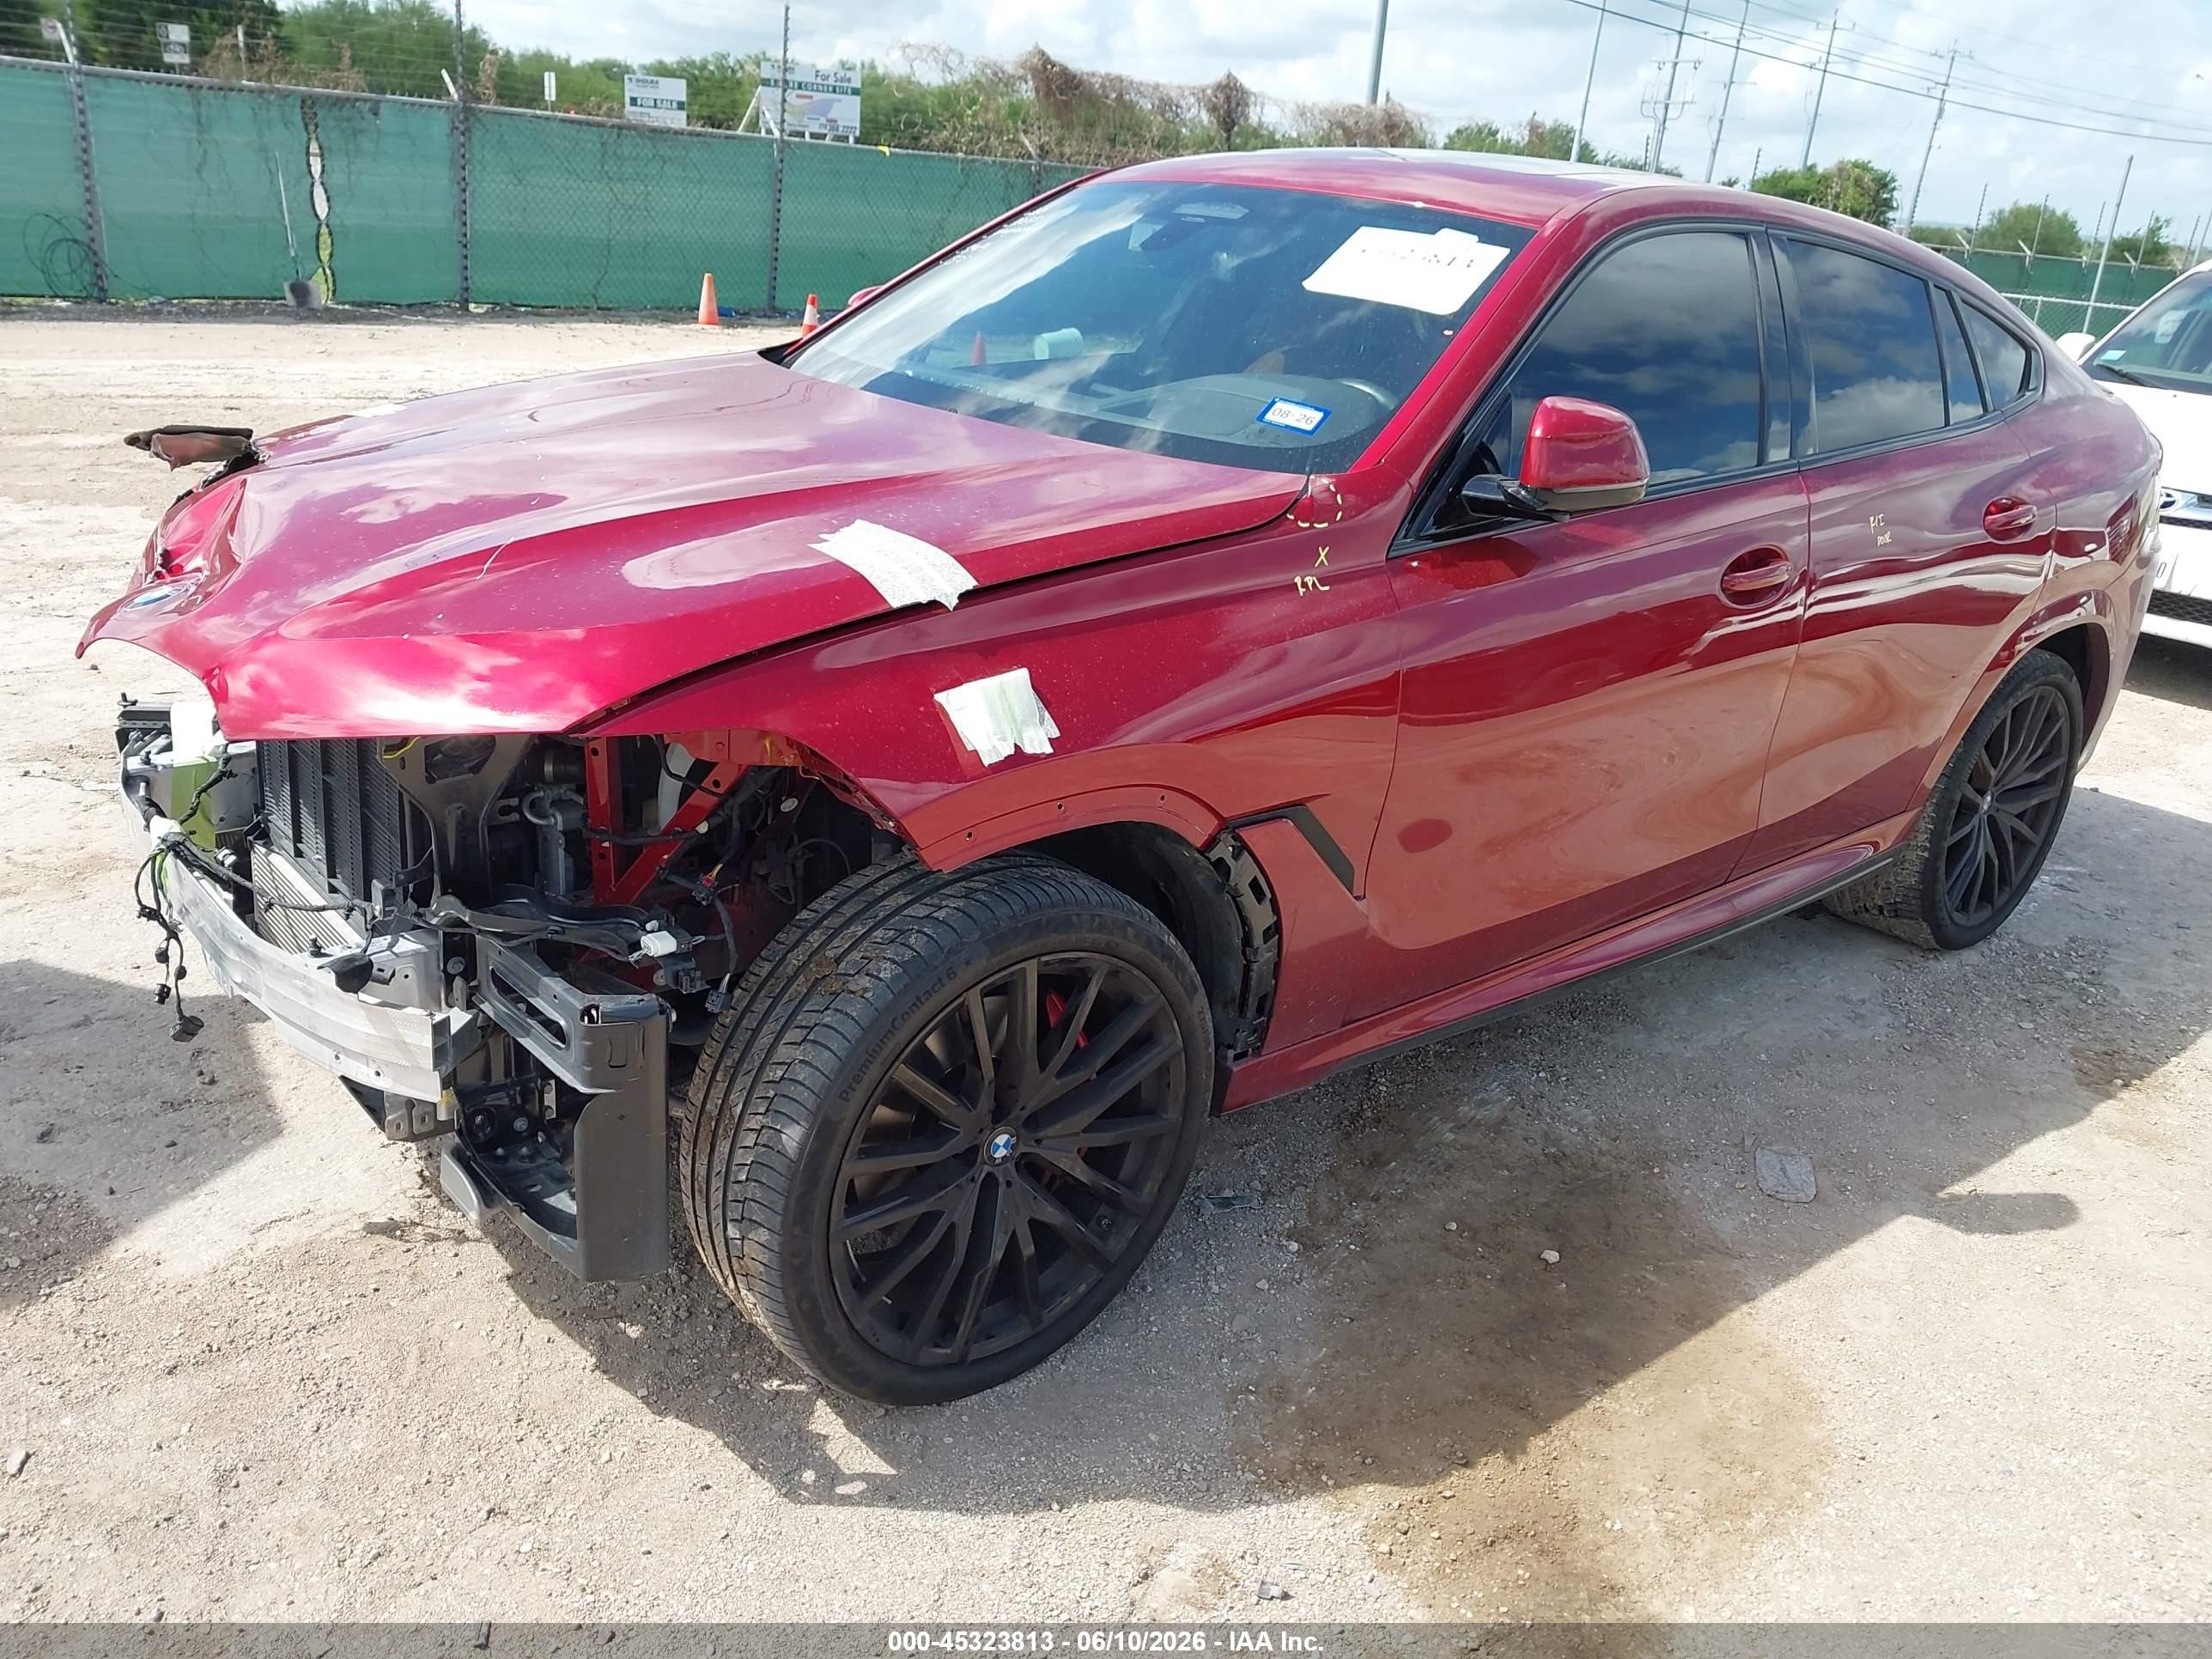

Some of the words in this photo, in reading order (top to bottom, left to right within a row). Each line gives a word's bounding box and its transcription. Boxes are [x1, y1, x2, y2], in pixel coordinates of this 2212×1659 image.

[814, 70, 831, 82] For
[833, 72, 852, 84] Sale
[1295, 413, 1316, 426] 26
[838, 976, 946, 1103] PremiumContact
[945, 966, 957, 981] 6
